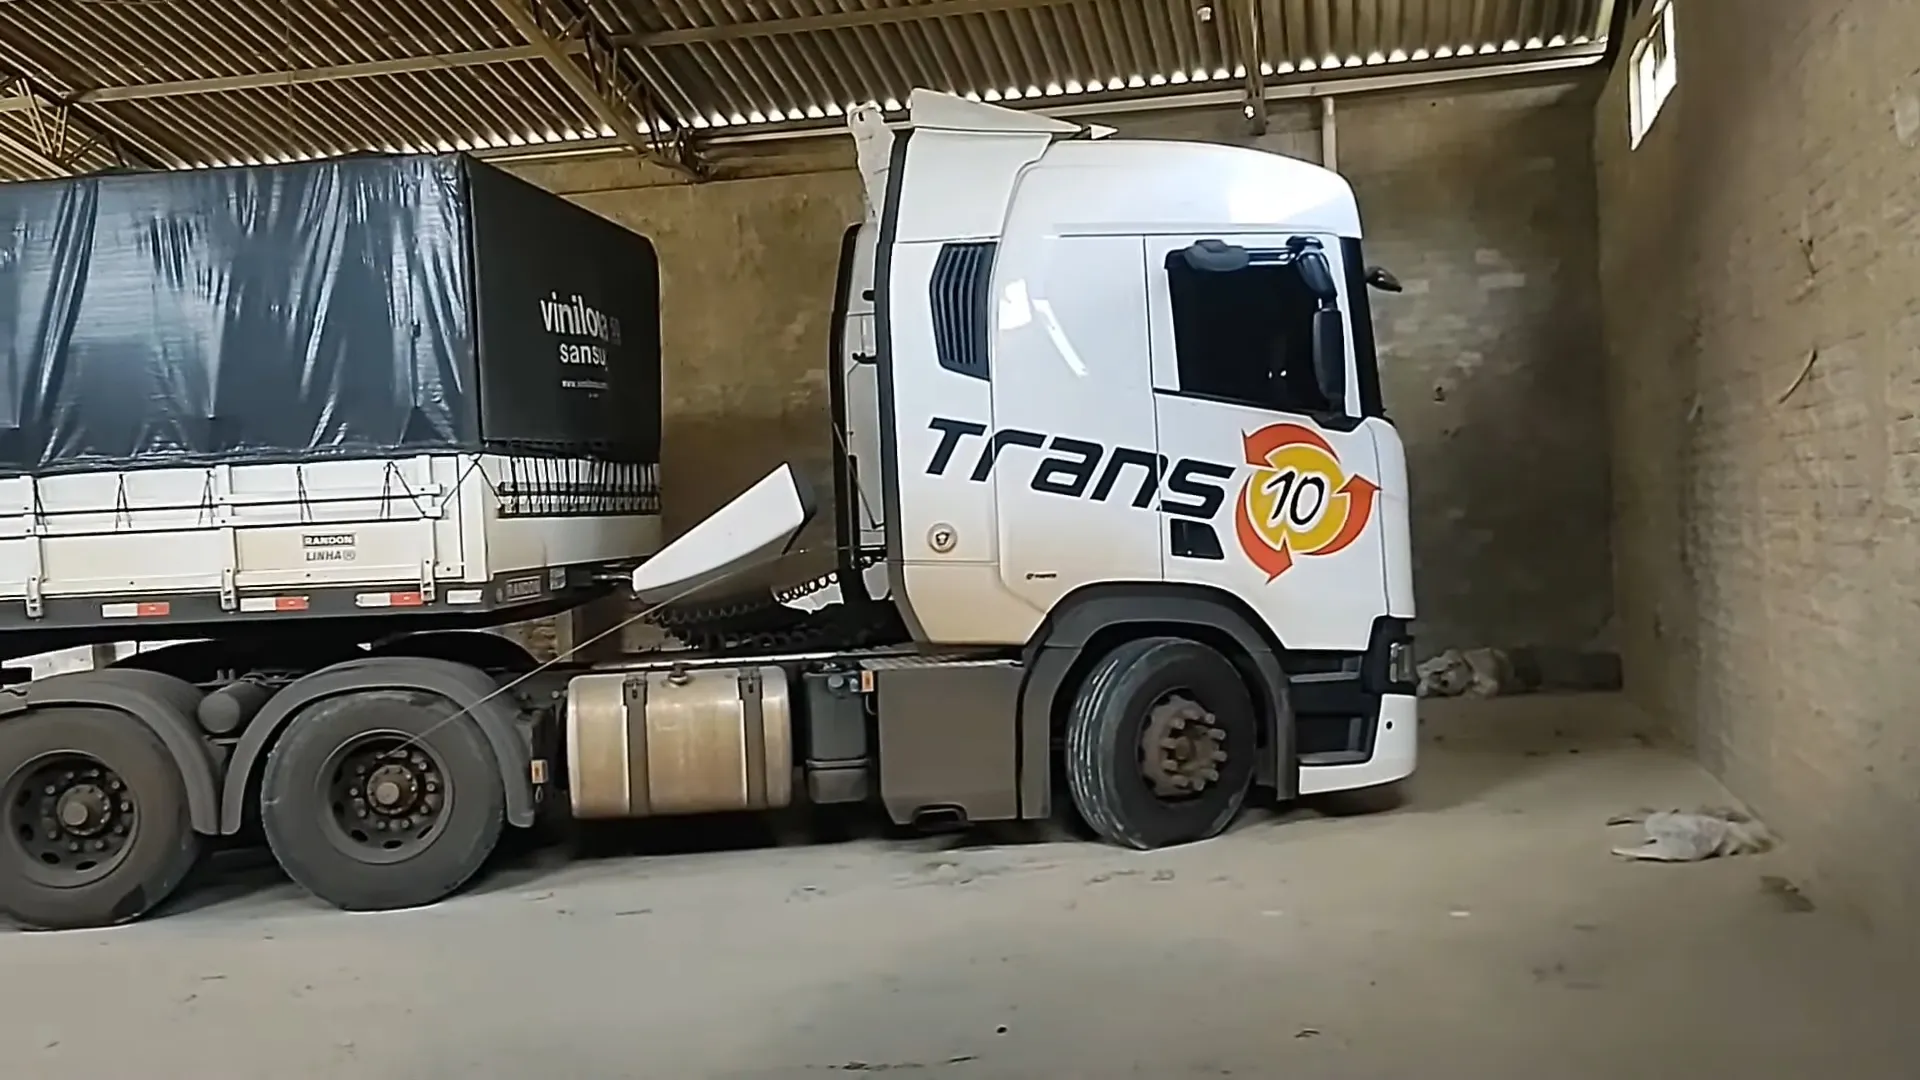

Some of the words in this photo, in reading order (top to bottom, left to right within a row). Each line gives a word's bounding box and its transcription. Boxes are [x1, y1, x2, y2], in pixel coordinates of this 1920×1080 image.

[560, 343, 608, 371] sansu
[925, 416, 1236, 520] Trans
[1266, 470, 1326, 523] 10
[304, 535, 353, 546] RANDON
[306, 550, 342, 561] LINHA
